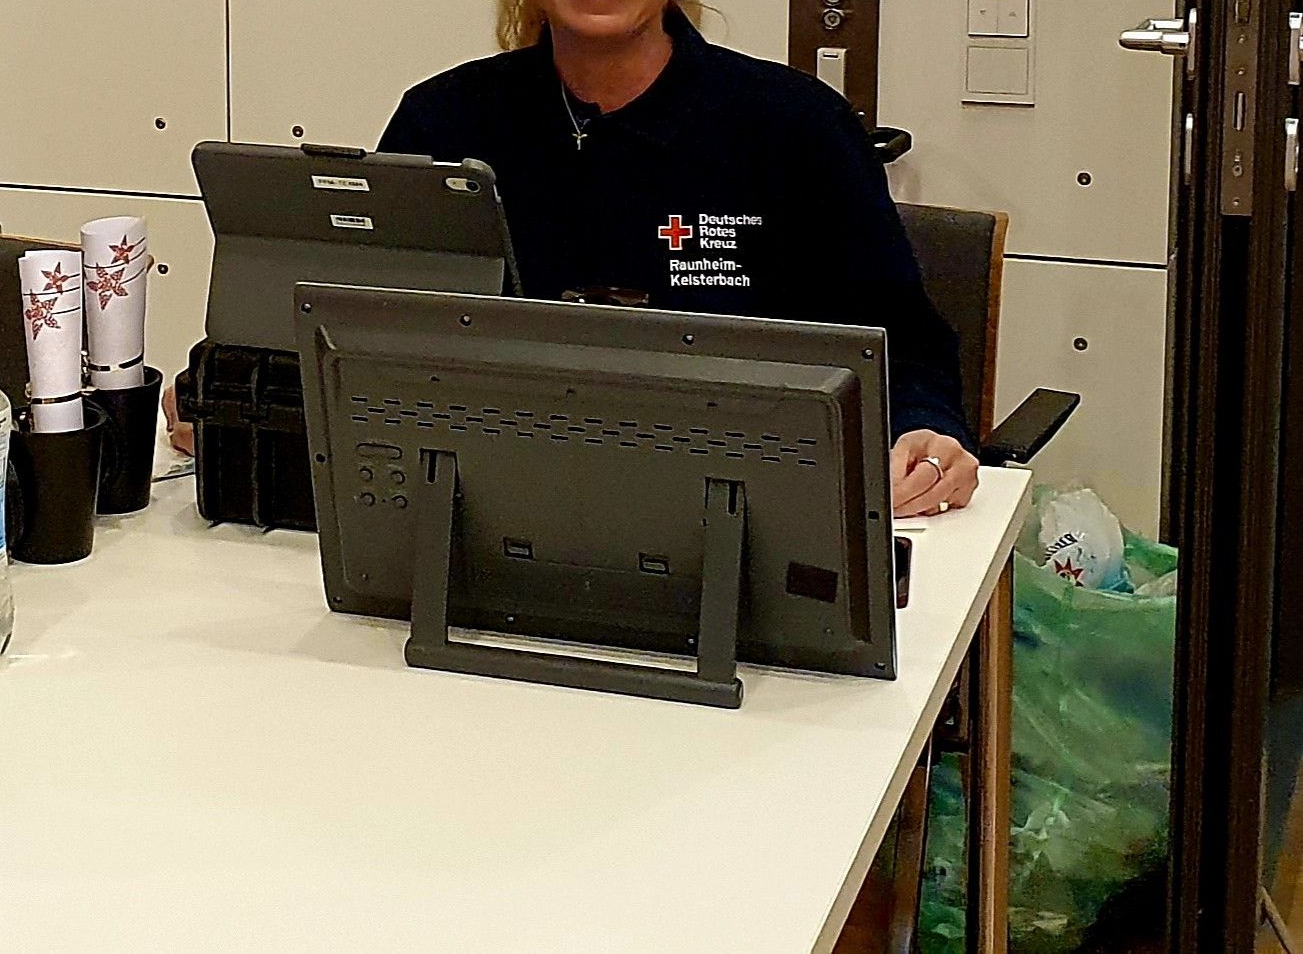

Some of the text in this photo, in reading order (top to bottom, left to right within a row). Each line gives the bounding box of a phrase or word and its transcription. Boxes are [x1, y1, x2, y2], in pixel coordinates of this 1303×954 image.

[698, 213, 763, 226] Deutsches
[699, 225, 737, 238] Rotes
[699, 237, 738, 249] Kreuz
[669, 257, 743, 272] Raunheim-
[670, 273, 751, 287] Kelsterbach
